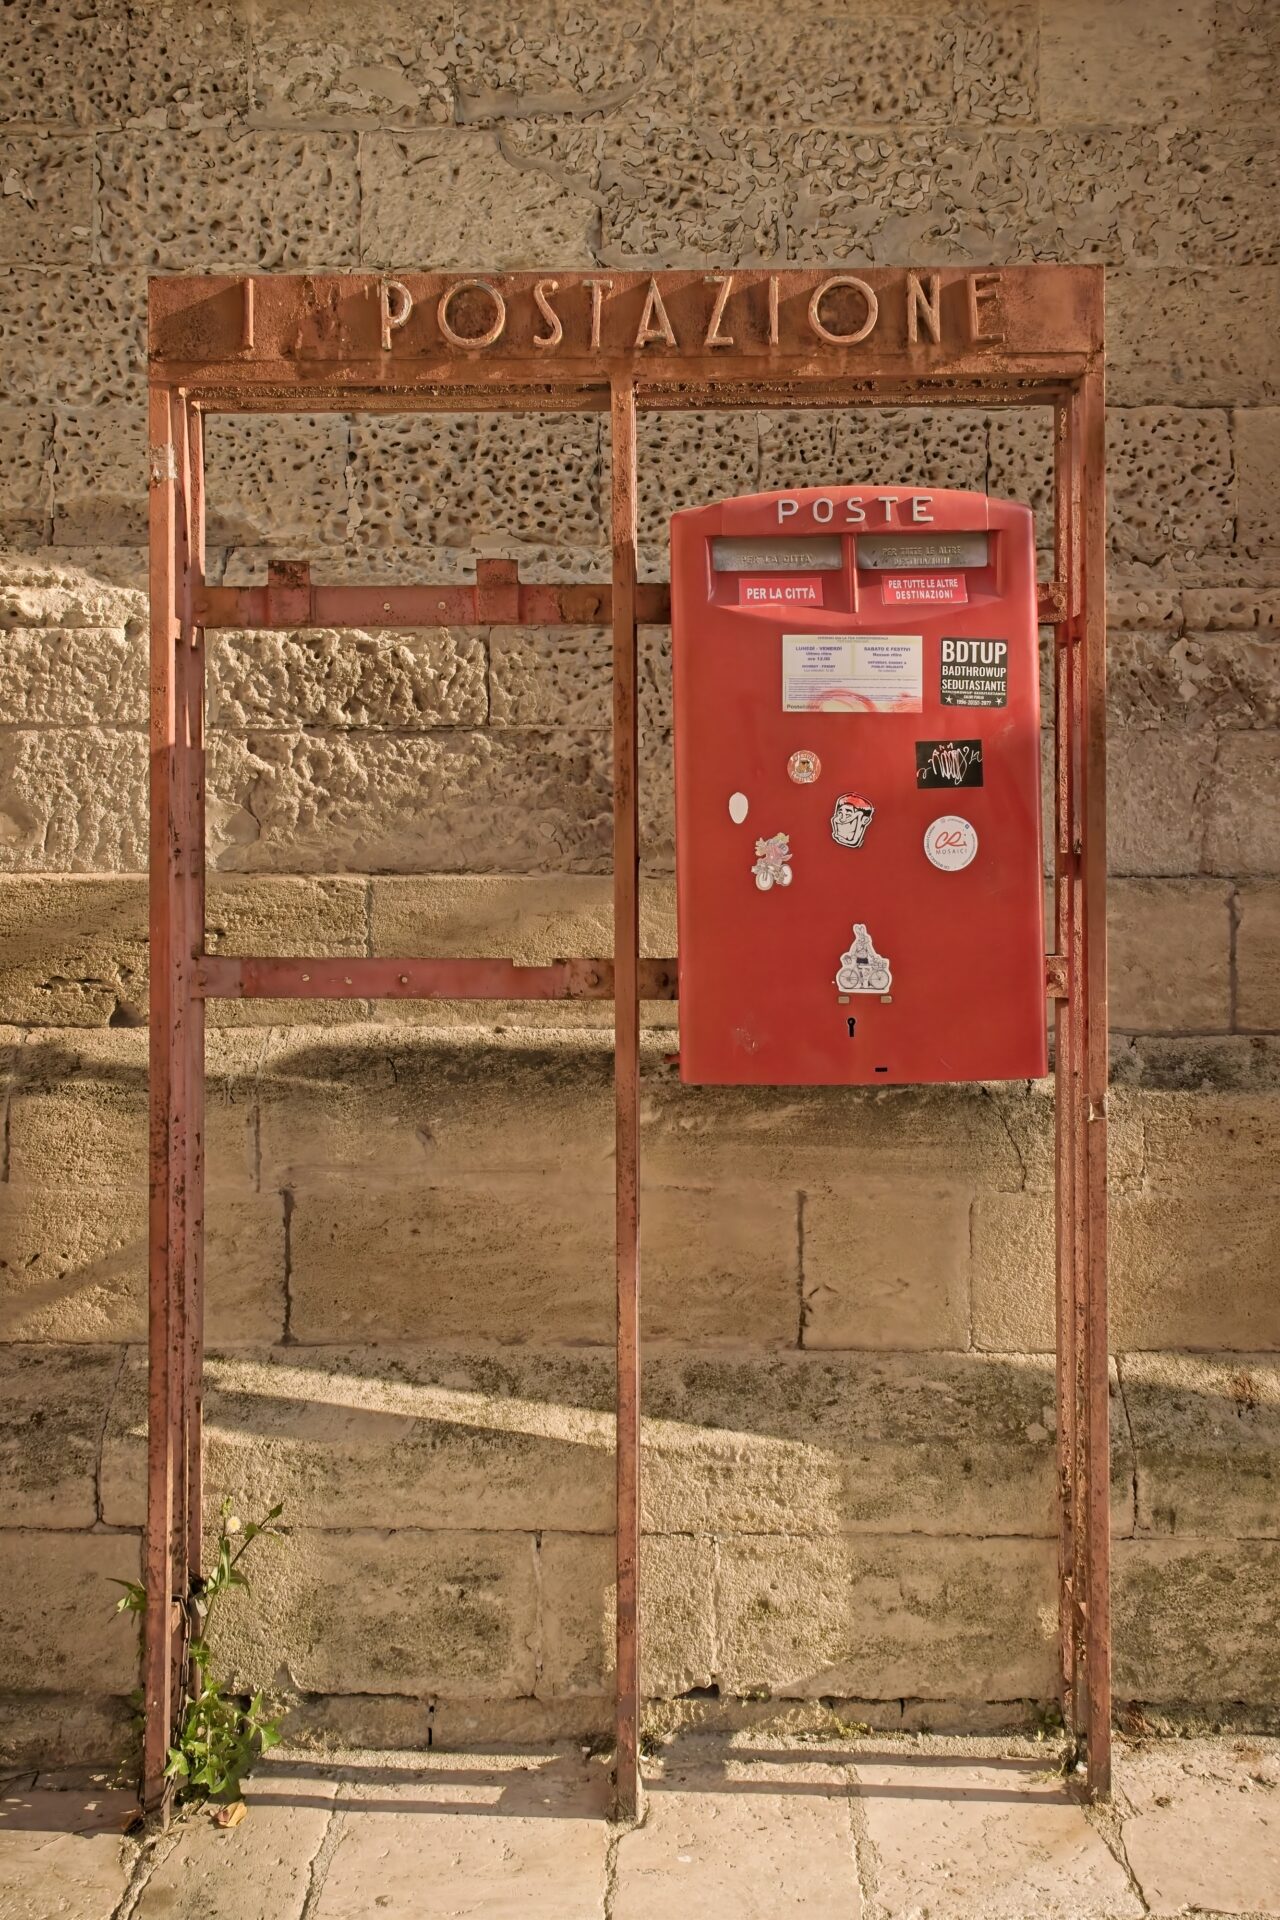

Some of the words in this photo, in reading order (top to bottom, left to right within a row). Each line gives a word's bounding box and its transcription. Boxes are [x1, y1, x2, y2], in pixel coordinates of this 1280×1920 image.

[379, 273, 1004, 351] POSTAZIONE
[777, 496, 934, 524] POSTE
[888, 580, 902, 589] PER
[904, 580, 925, 588] TUTTE
[926, 580, 935, 588] LE
[936, 578, 958, 587] ALTRE
[746, 588, 767, 599] PER
[769, 588, 782, 599] LA
[785, 585, 816, 599] CITTÀ
[896, 590, 953, 599] DESTINAZIONI
[942, 640, 1007, 664] BDTUP
[942, 665, 1007, 678] BADTHROWUP
[942, 679, 1006, 692] SEDUTASTANTE
